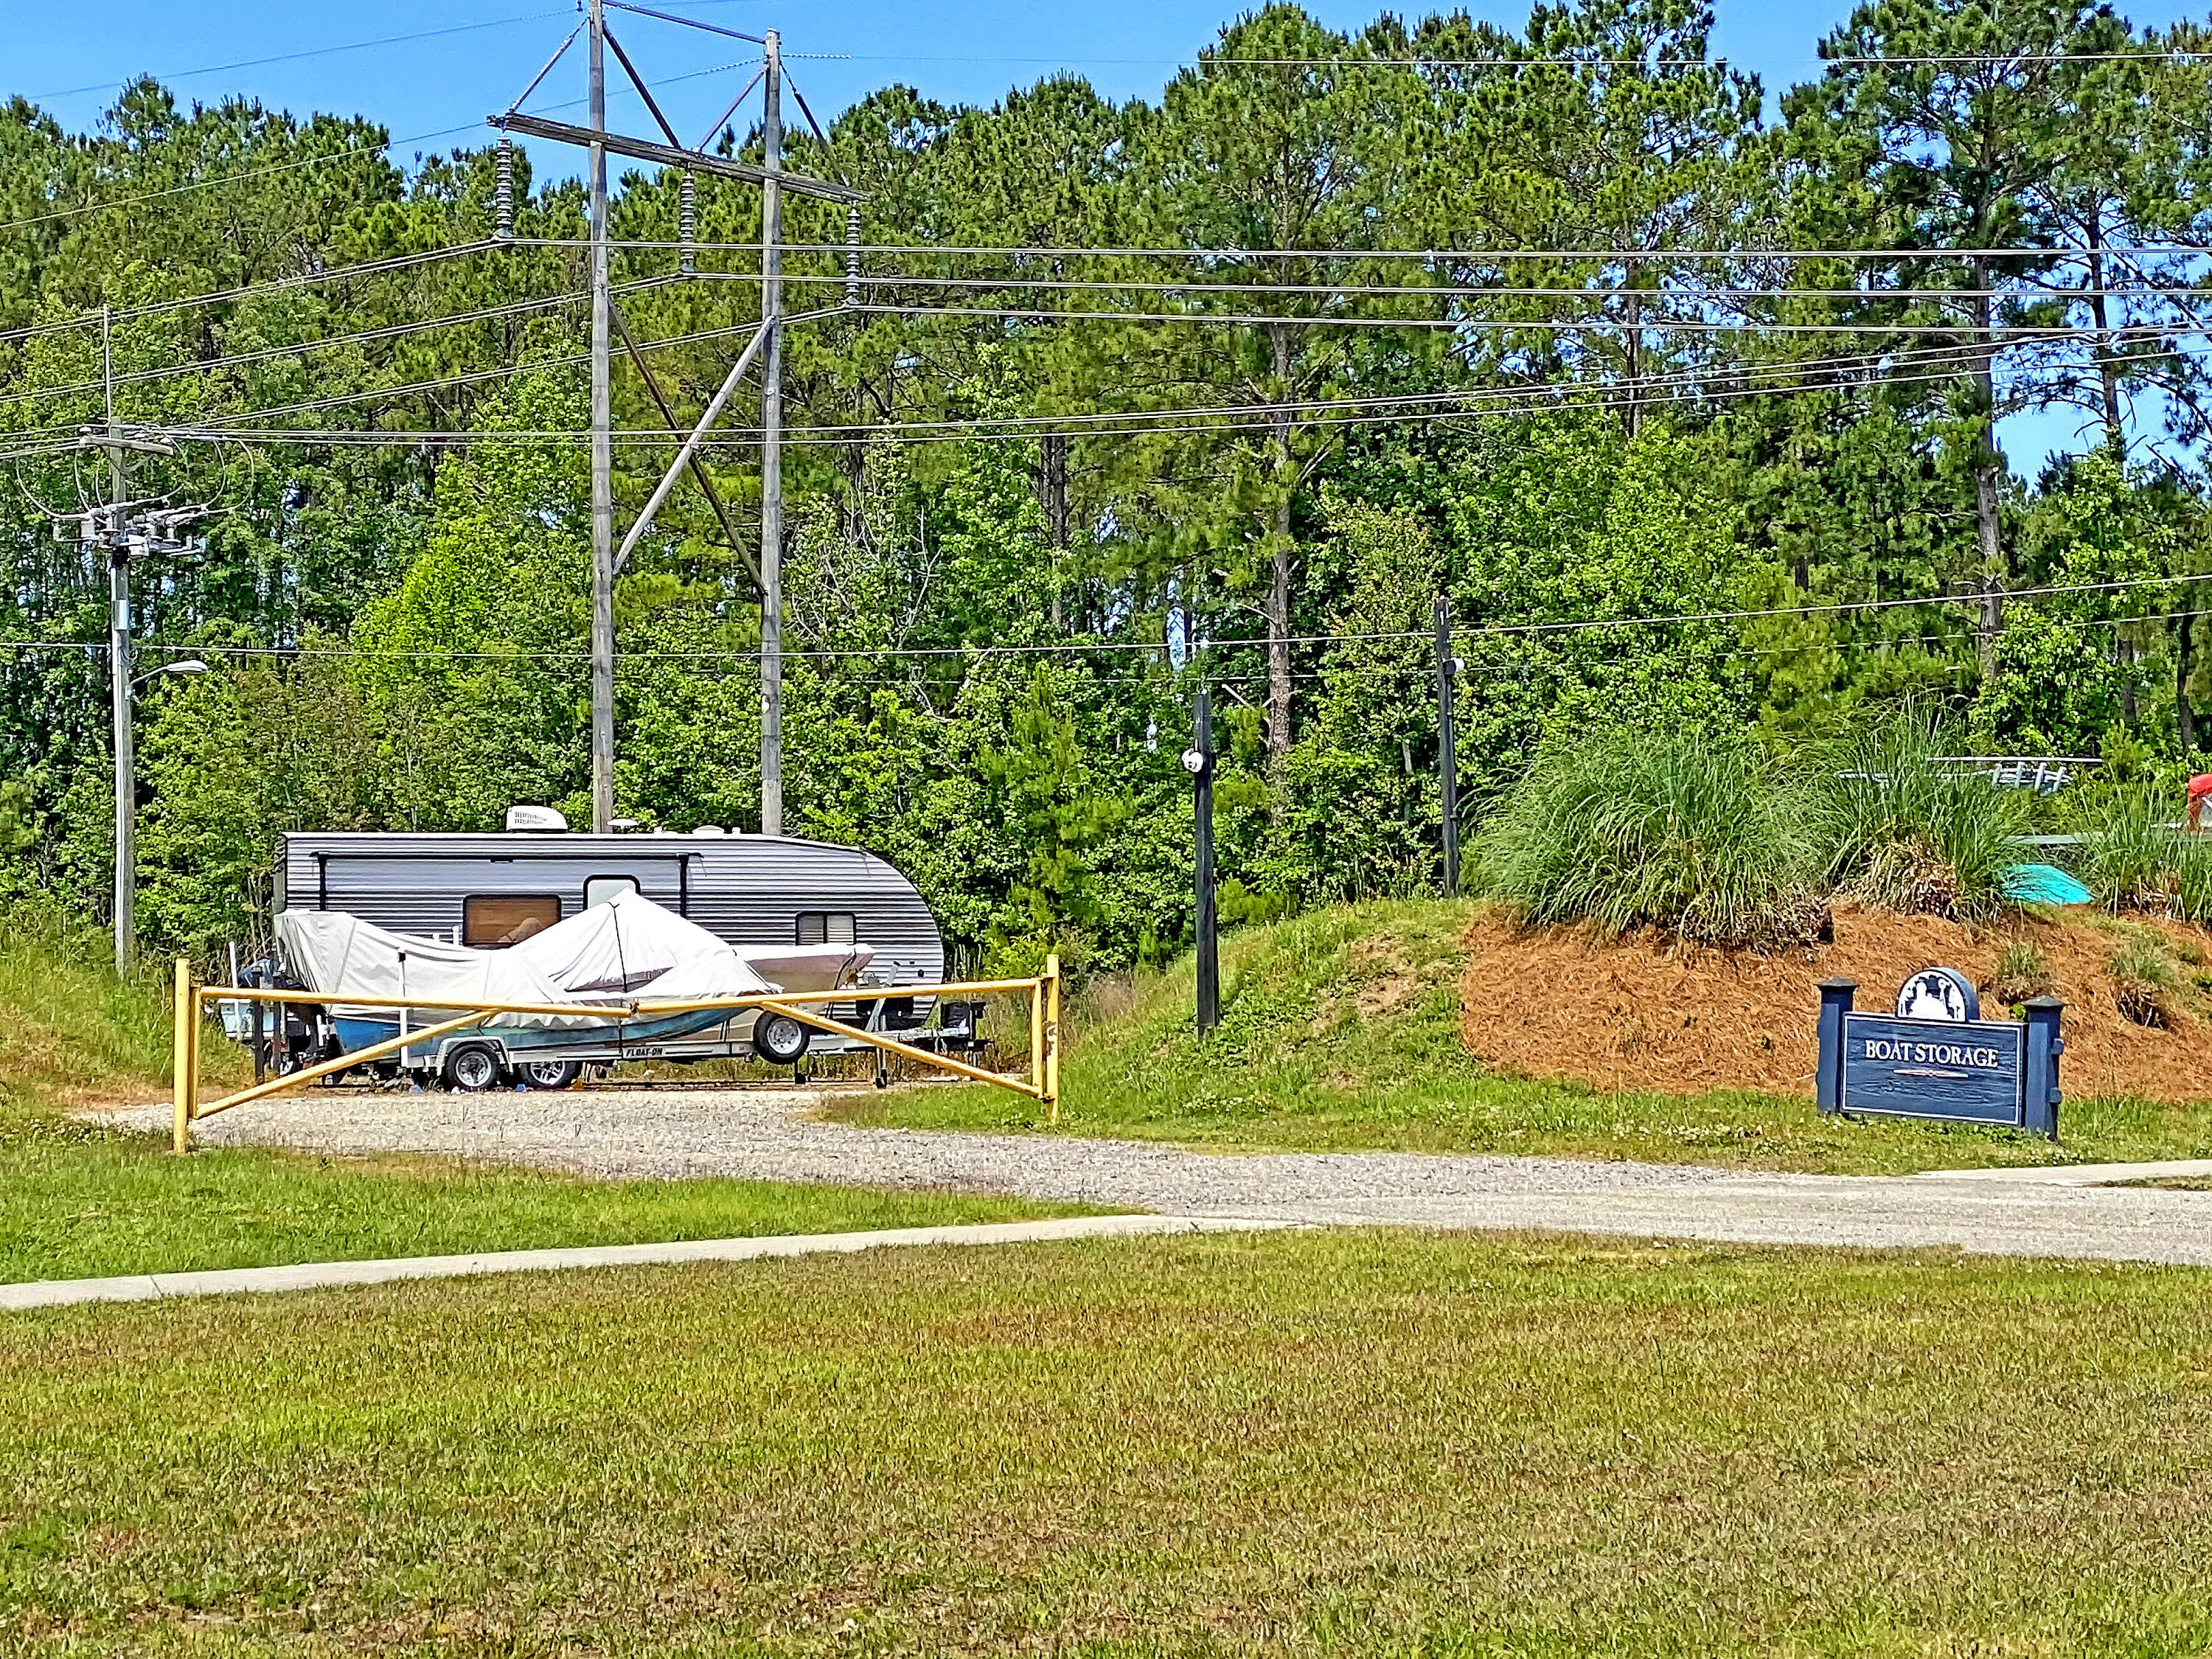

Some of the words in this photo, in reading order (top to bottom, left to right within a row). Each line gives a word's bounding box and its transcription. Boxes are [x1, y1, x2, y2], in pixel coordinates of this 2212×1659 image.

[626, 1048, 663, 1057] FLOAT-ON
[1865, 1040, 1913, 1061] BOAT
[1914, 1043, 1999, 1068] STORAGE
